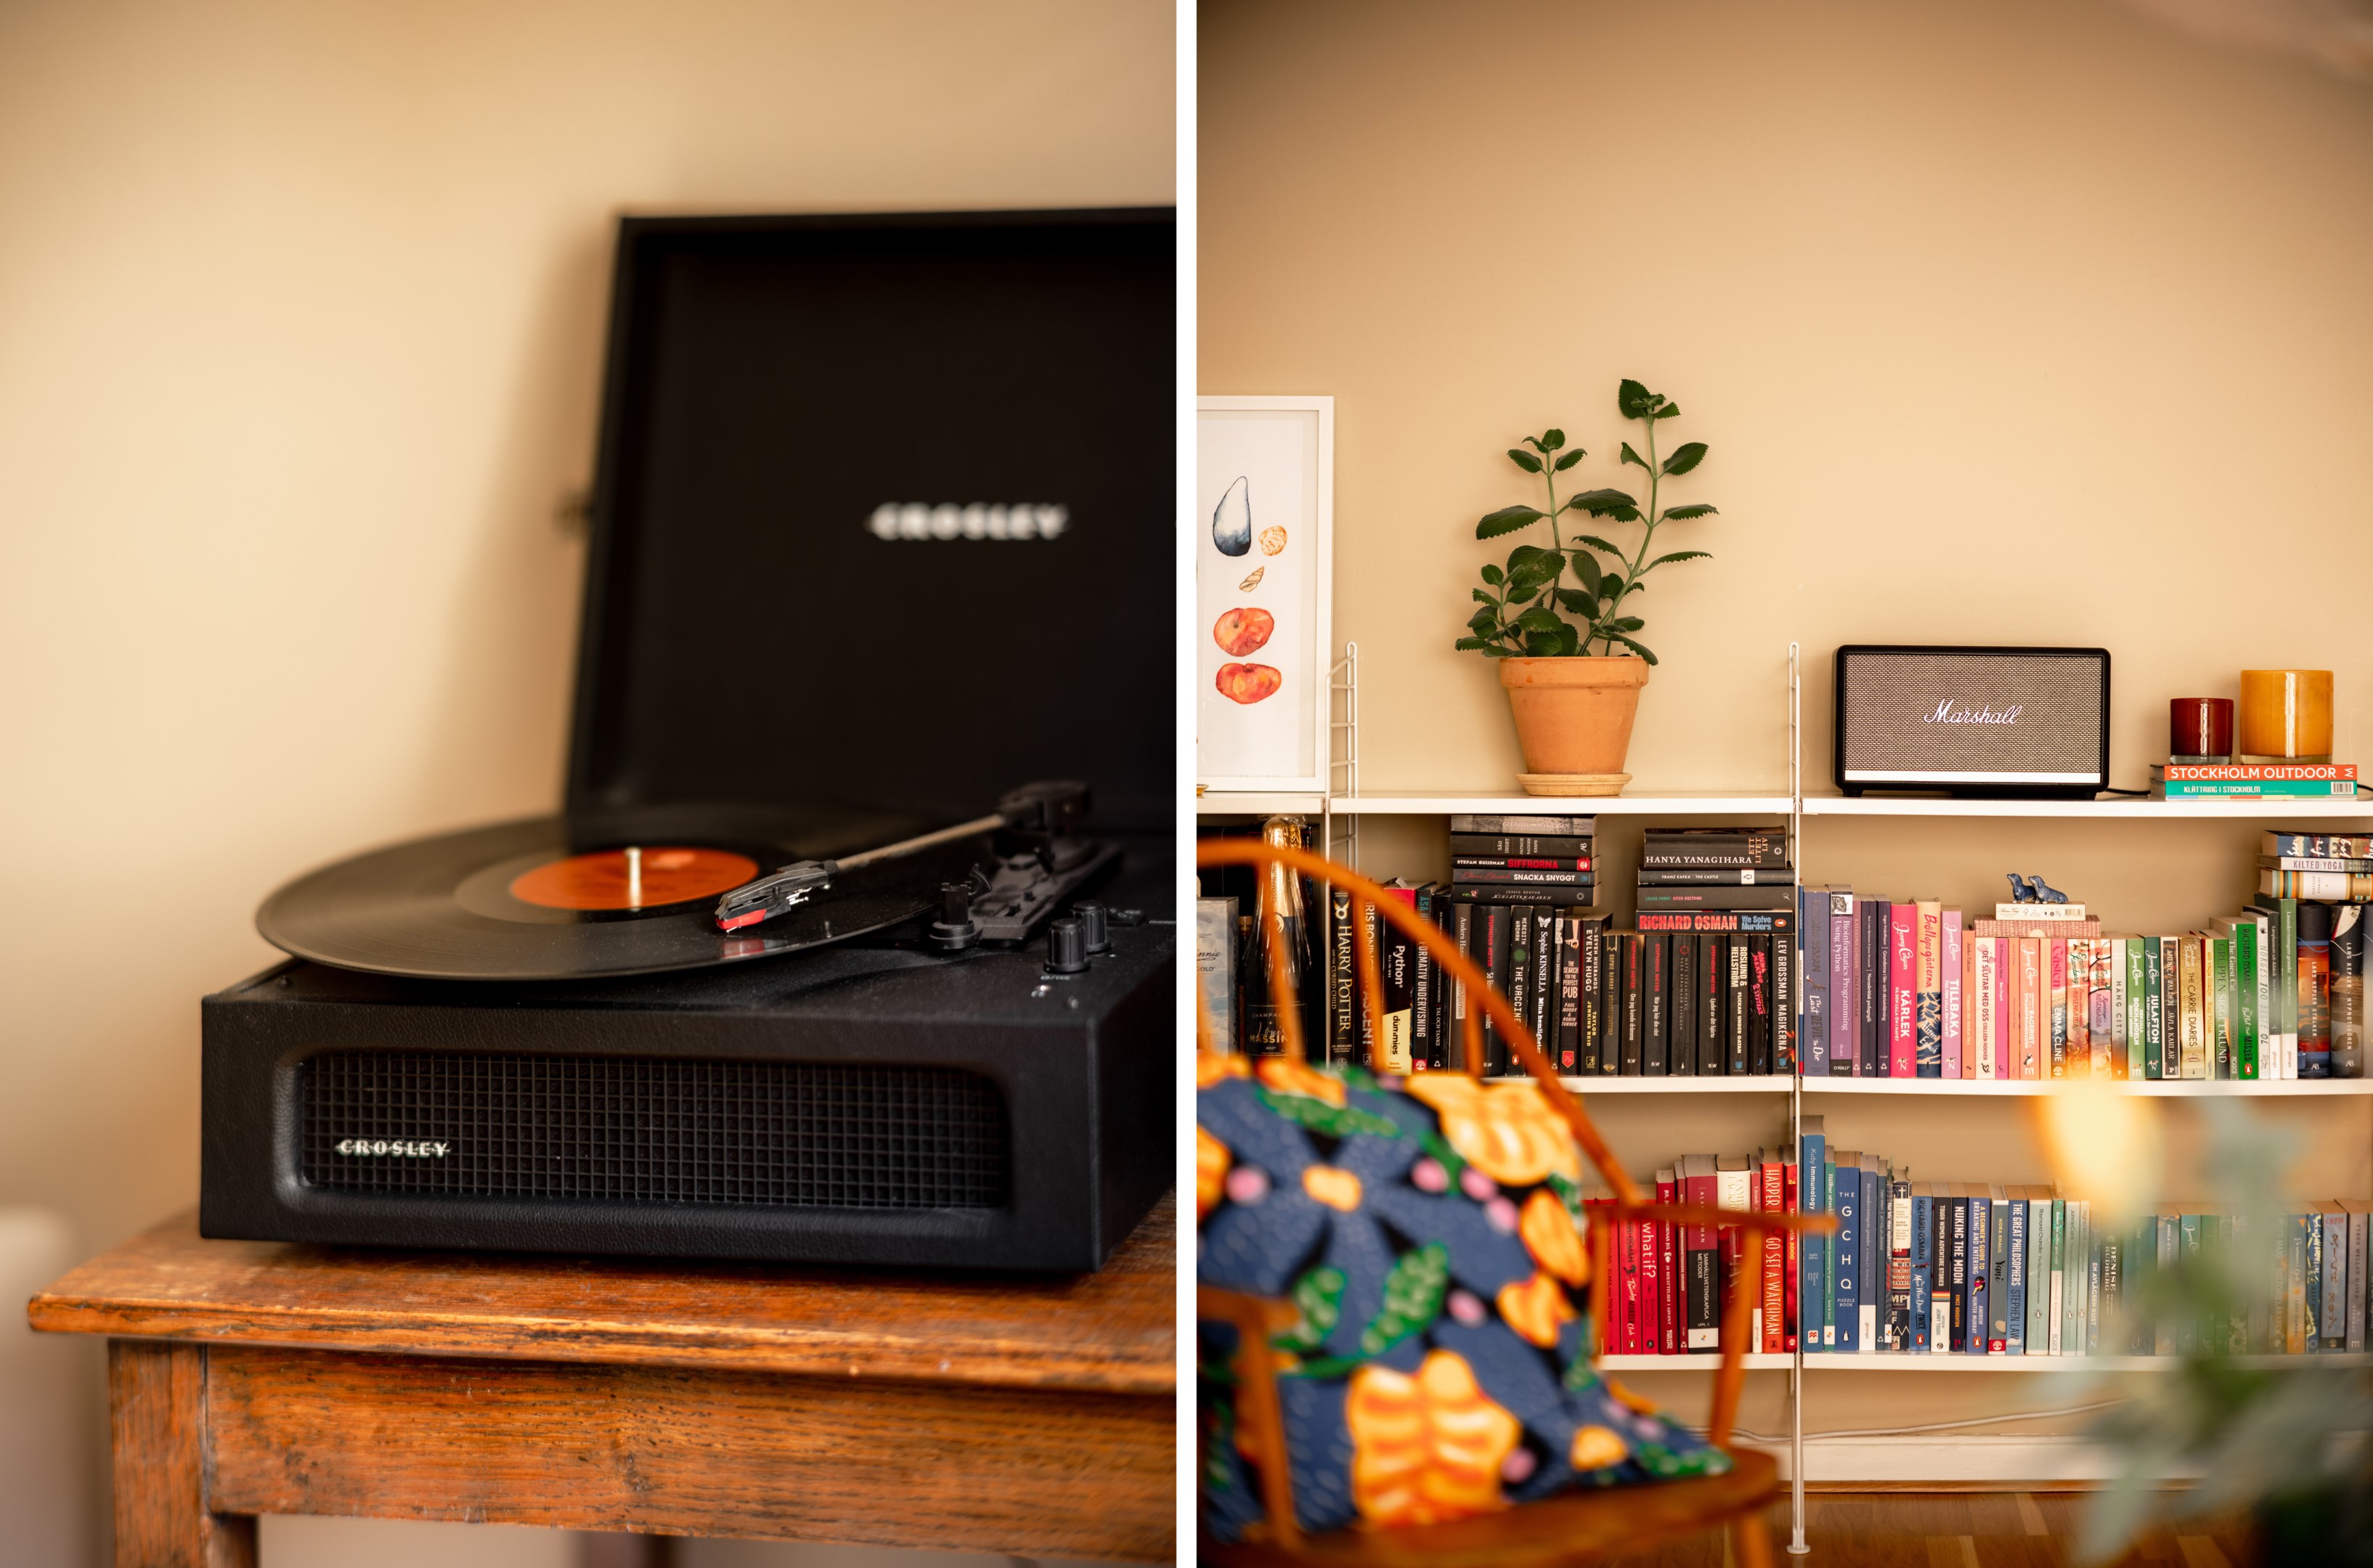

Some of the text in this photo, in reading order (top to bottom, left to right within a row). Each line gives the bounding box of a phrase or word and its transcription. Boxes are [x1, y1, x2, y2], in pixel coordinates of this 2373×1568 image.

[864, 502, 1070, 540] CROSLEY
[1924, 698, 2022, 724] Marshall
[2171, 767, 2337, 778] STOCKHOLM OUTDOOR
[1507, 859, 1558, 869] SIFFRORNA
[1694, 915, 1737, 930] OSMAN
[1338, 925, 1352, 976] HARRY
[1539, 931, 1548, 954] Sophie
[1920, 914, 1937, 988] Bröllopsgästerna
[1394, 945, 1406, 984] Python
[1731, 947, 1740, 987] HELLSTRÖM
[1778, 940, 1787, 1000] LEV GROSSMAN
[2217, 944, 2226, 992] GRUPPEN
[1417, 942, 1428, 1037] FORMATIV UNDERVISNING
[1563, 987, 1577, 998] PUB
[2188, 985, 2197, 1013] CARRIE
[1338, 979, 1352, 1034] POTTER
[1900, 990, 1911, 1037] KÄRLEK
[1950, 979, 1958, 1037] TILLBAKA
[1778, 1005, 1786, 1050] MAGIKERNA
[2189, 1017, 2197, 1047] DIARIES
[2260, 1034, 2268, 1045] ØL
[335, 1140, 450, 1158] CROSLEY
[1765, 1169, 1780, 1206] HARPER
[1841, 1206, 1852, 1217] G
[1842, 1230, 1851, 1241] C
[1953, 1206, 1964, 1283] NUKING THE MOON
[2011, 1204, 2022, 1286] THE GREAT PHILOSOPHERS
[2182, 1224, 2195, 1242] Jenny
[1643, 1222, 1656, 1278] what if?
[1842, 1254, 1851, 1265] H
[1995, 1260, 2006, 1283] Yani
[2093, 1262, 2097, 1272] EN
[1841, 1279, 1852, 1289] Q
[2010, 1289, 2021, 1340] STEPHEN LAW
